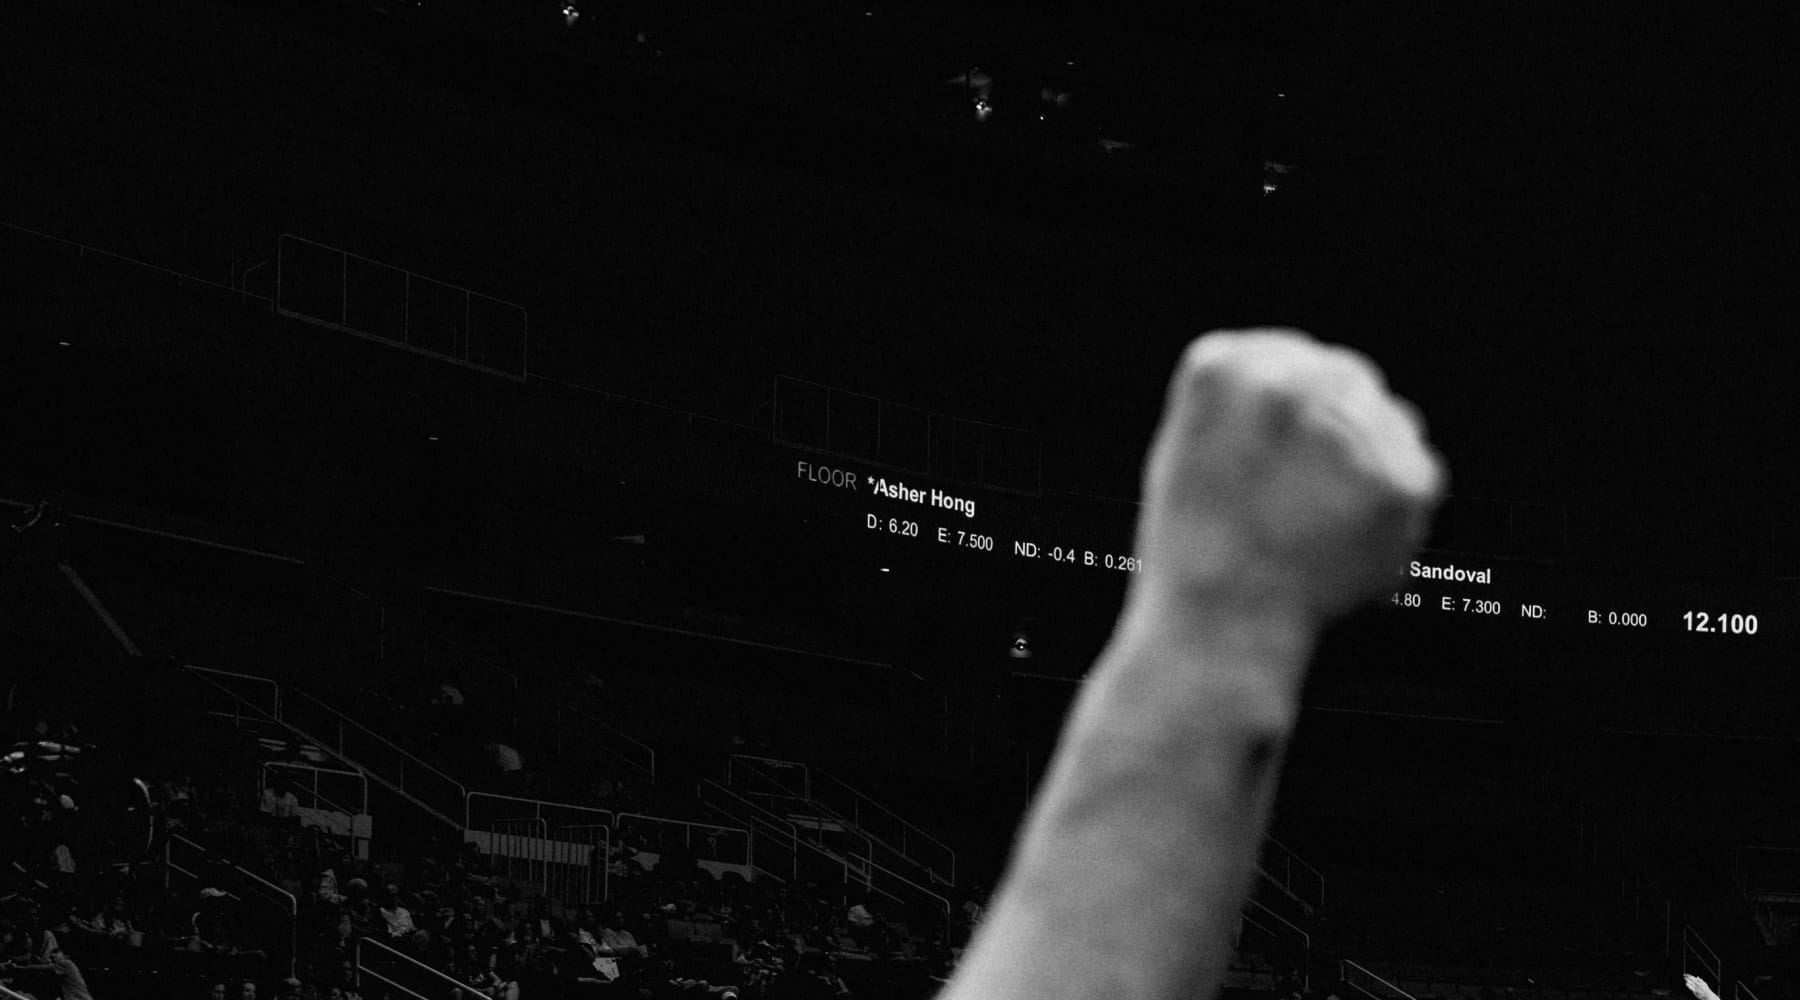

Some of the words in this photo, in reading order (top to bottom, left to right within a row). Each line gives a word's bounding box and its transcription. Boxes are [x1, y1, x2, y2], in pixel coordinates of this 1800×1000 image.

[797, 460, 857, 491] FLOOR
[931, 488, 975, 518] Hong
[867, 513, 883, 531] D:
[888, 517, 919, 537] 6.20
[937, 527, 951, 544] E:
[957, 530, 994, 552] 7.500
[1014, 540, 1041, 559] ND:
[1047, 546, 1076, 563] -0.4
[1084, 550, 1098, 567] B:
[1409, 560, 1491, 585] Sandoval
[1441, 596, 1456, 611] E:
[1462, 597, 1501, 615] 7.300
[1521, 603, 1546, 619] ND:
[1588, 609, 1602, 624] B:
[1608, 611, 1648, 627] 0.000
[1683, 610, 1758, 635] 12.100
